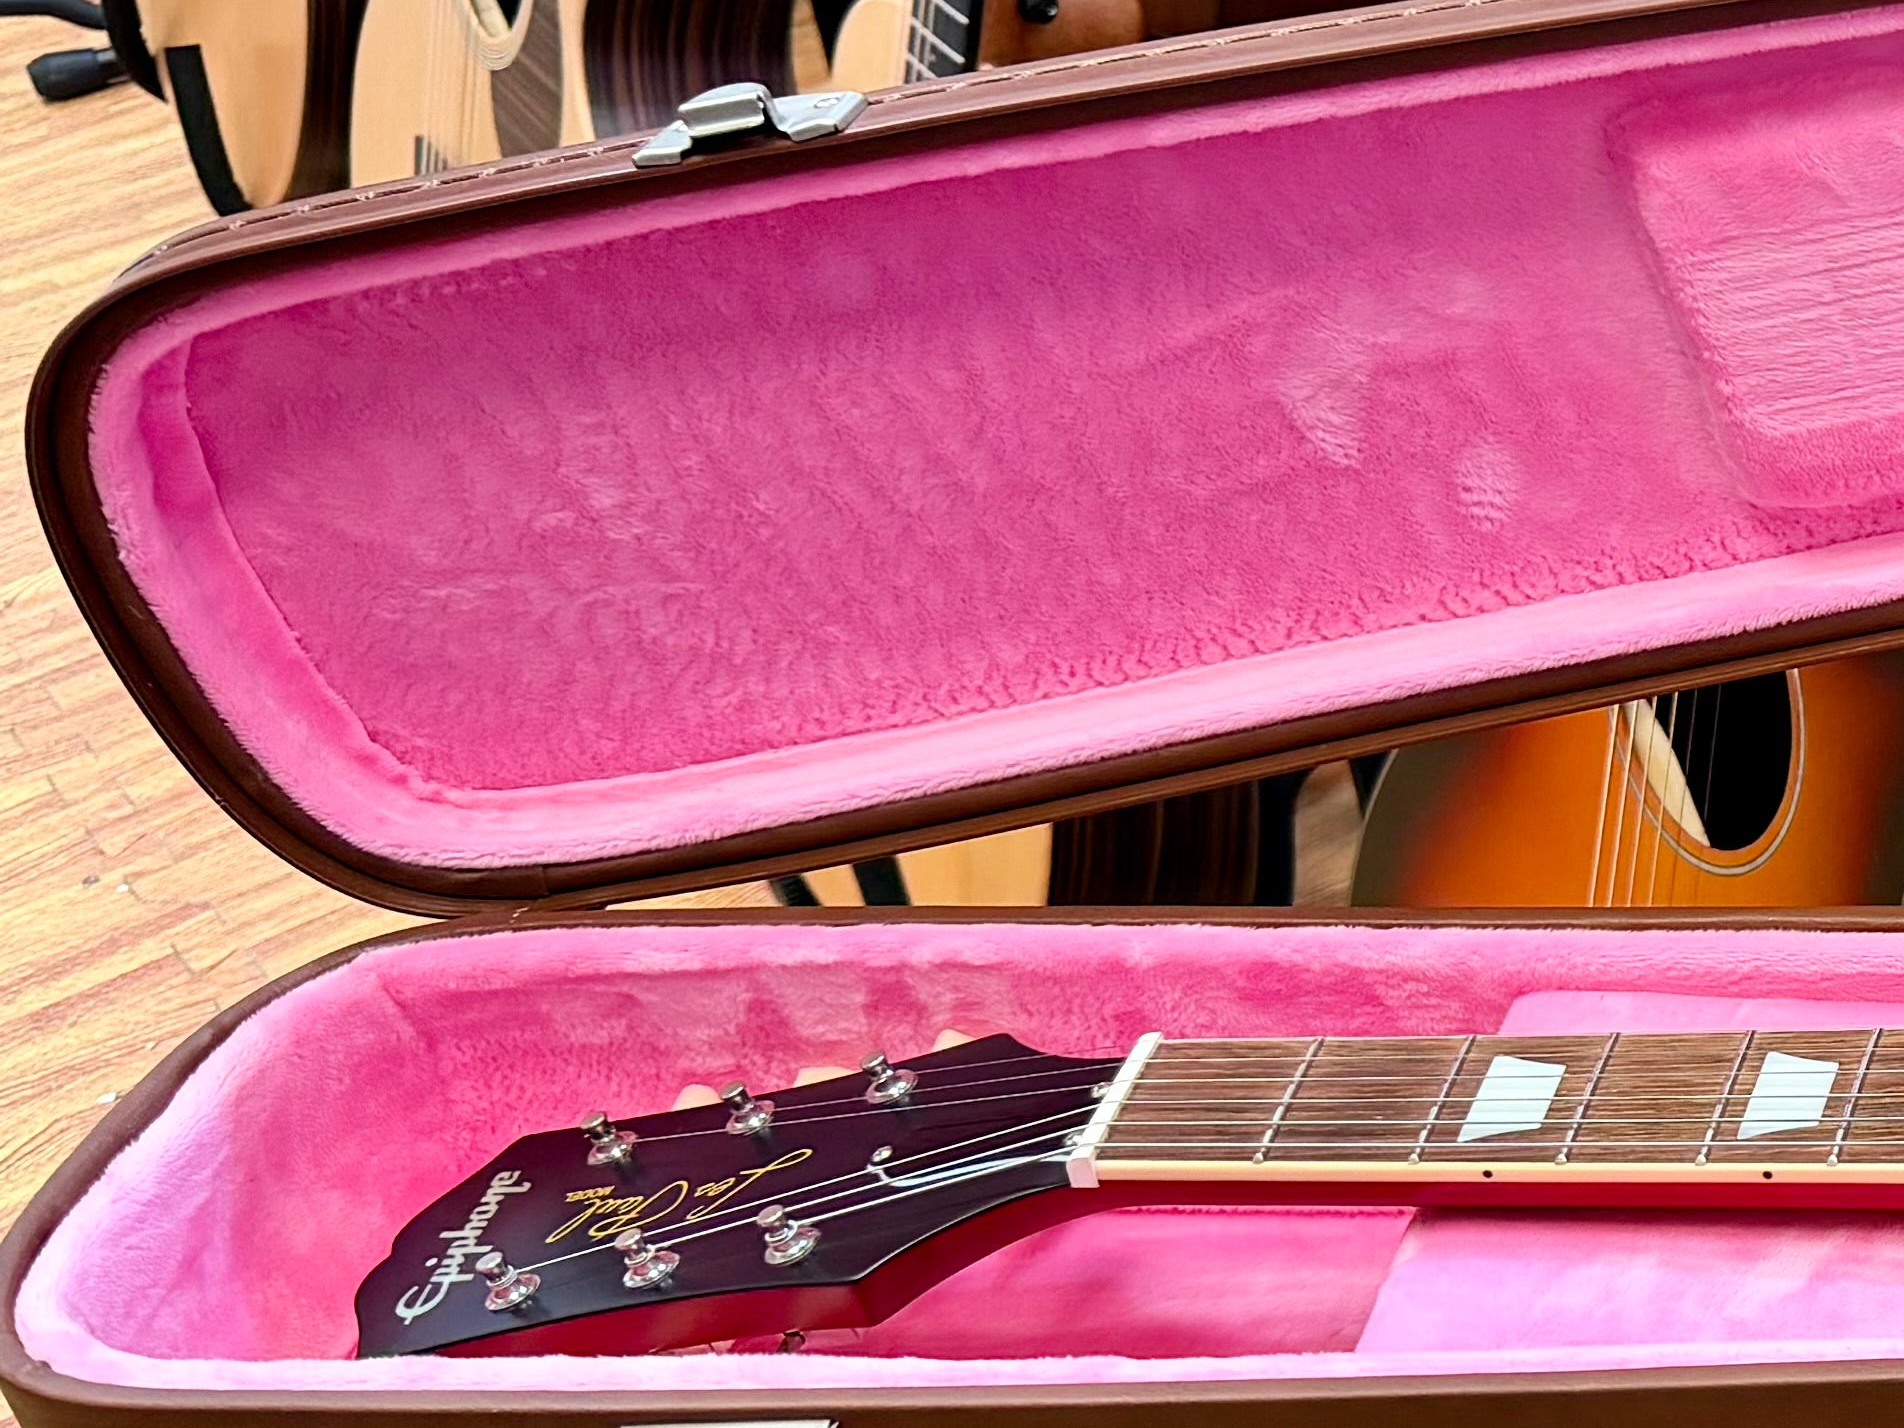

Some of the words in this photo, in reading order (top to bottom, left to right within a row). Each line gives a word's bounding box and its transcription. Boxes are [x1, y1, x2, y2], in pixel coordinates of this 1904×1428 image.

[544, 1179, 689, 1244] Paul
[564, 1184, 616, 1204] MODEL
[685, 1148, 813, 1221] Les
[394, 1169, 533, 1326] Epiphone
